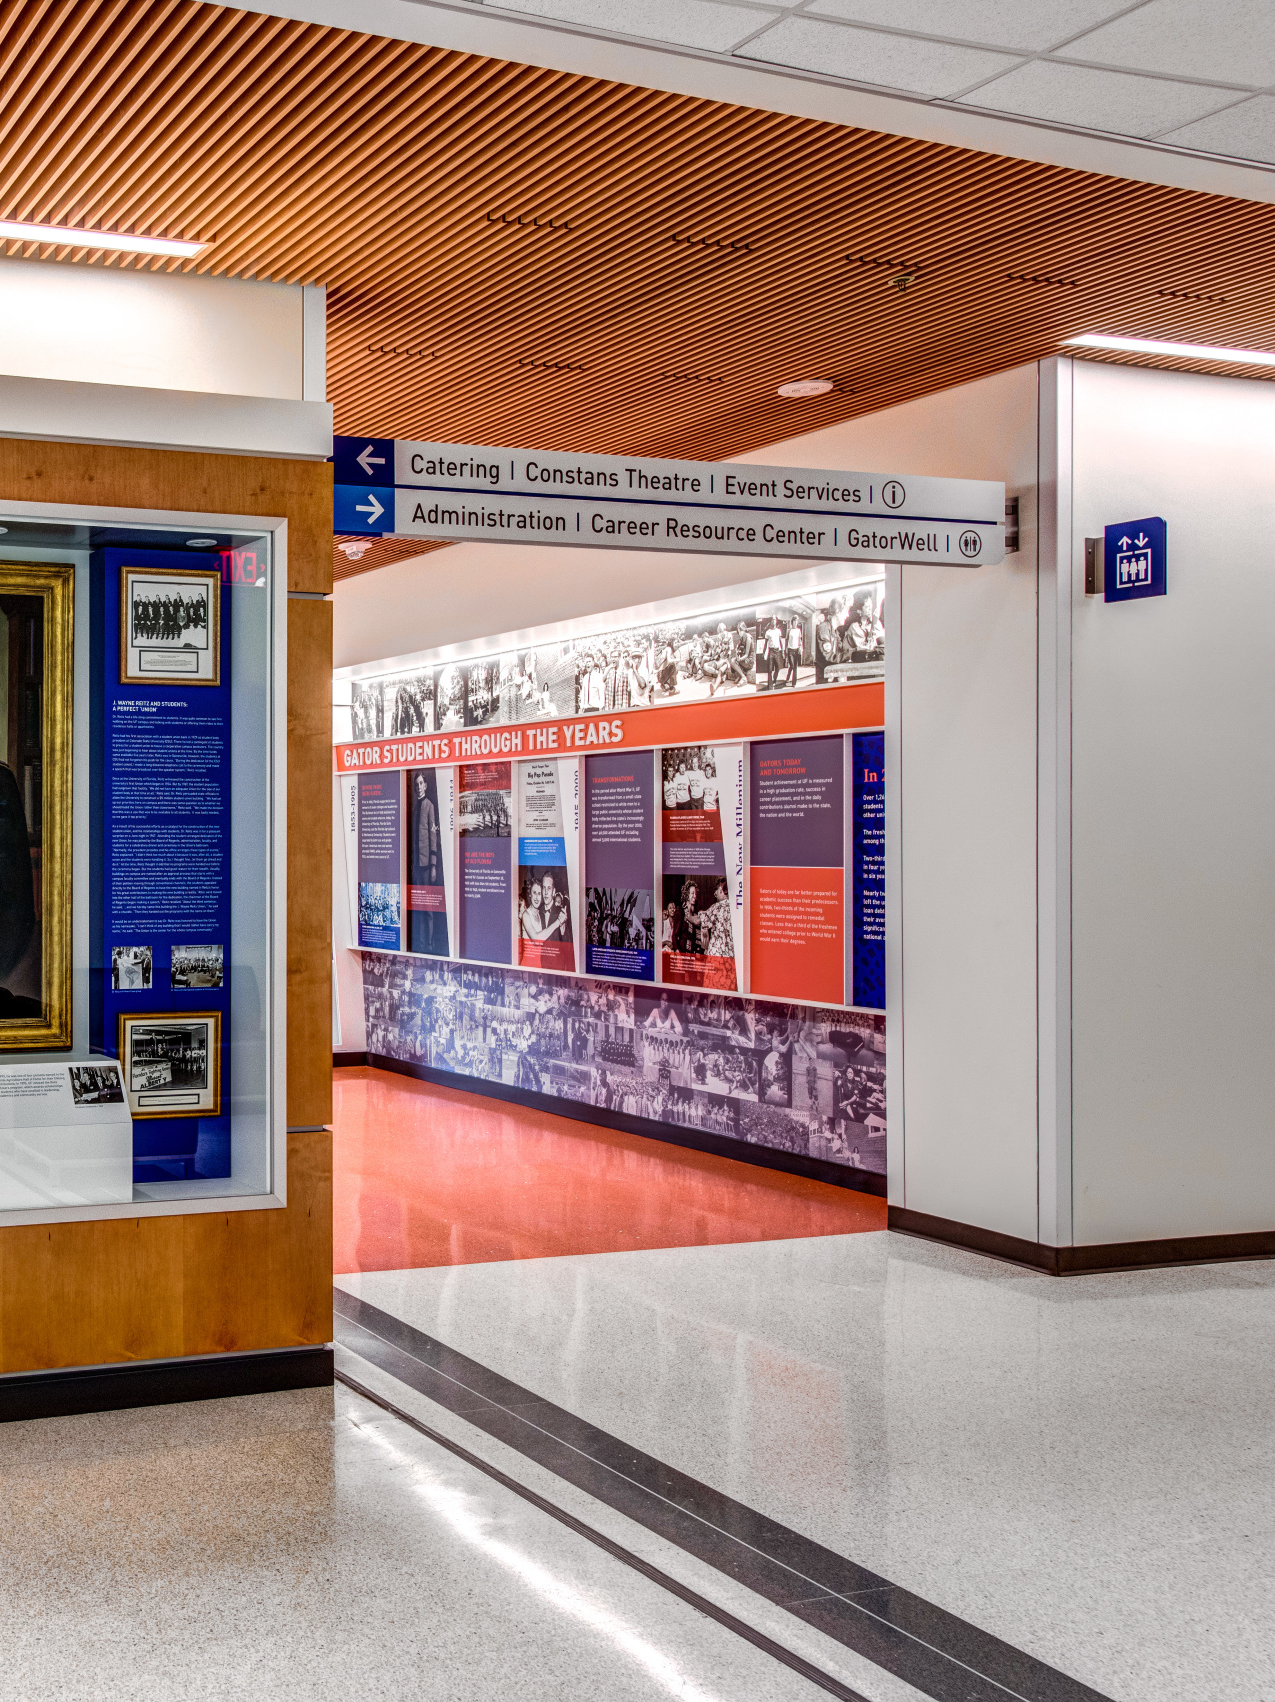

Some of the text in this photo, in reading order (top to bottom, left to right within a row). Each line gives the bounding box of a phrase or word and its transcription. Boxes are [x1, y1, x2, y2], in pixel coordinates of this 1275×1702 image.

[411, 454, 861, 503] Catering Constans Theatre Event Services
[412, 503, 938, 552] Administration Career Resource Center GatorWell
[343, 720, 624, 767] GATOR STUDENTS THROUGH THE YEARS
[773, 767, 805, 775] TOMORROW
[864, 769, 878, 783] In
[863, 890, 879, 898] Nearly
